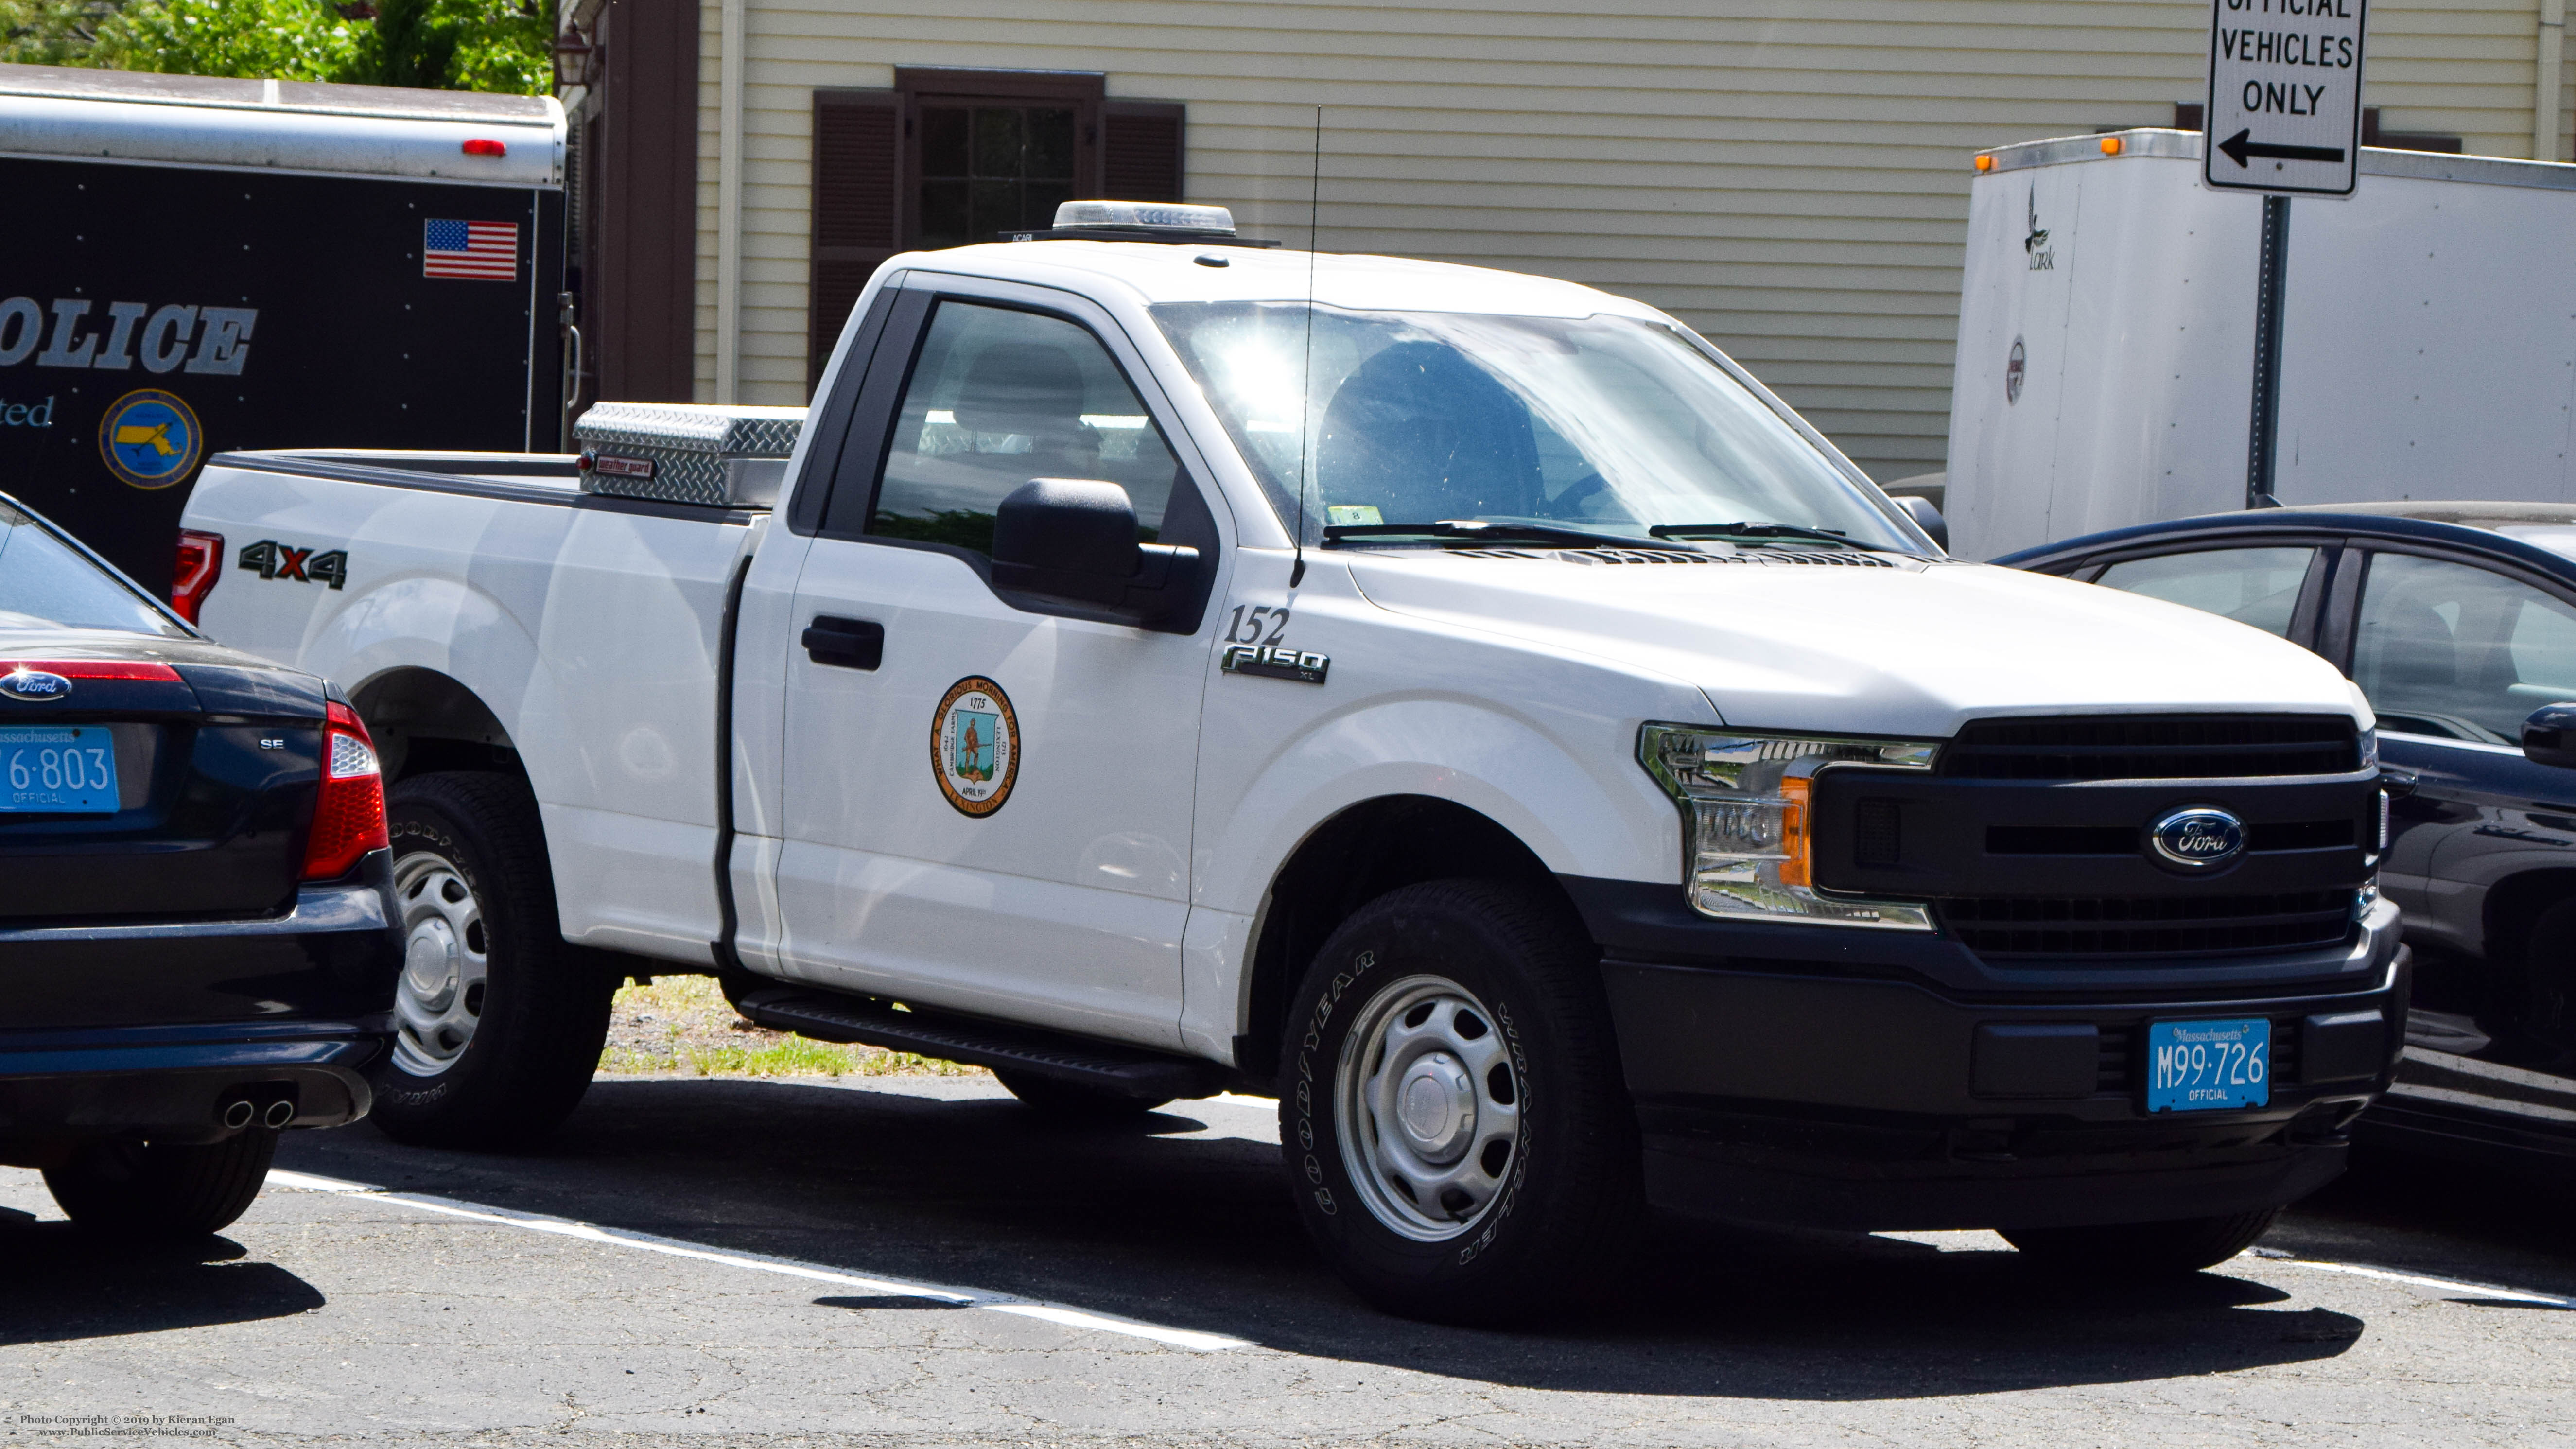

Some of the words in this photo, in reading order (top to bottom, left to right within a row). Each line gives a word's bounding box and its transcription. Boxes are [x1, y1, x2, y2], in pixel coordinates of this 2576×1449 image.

[2222, 28, 2353, 68] VEHICLES
[2244, 80, 2326, 115] ONLY
[0, 296, 259, 375] OLICE
[0, 395, 54, 428] ted
[599, 458, 627, 471] weather
[1224, 604, 1290, 646] 152
[17, 676, 56, 693] Ford
[1300, 671, 1314, 680] XL
[938, 681, 972, 720] GLORIOUS
[976, 681, 1008, 713] MORNING
[1007, 716, 1016, 738] FOR
[970, 697, 986, 709] 1775
[260, 739, 284, 749] SE
[13, 793, 66, 803] OFFICIAL
[962, 787, 976, 797] APRIL
[2179, 821, 2228, 851] Ford
[2176, 1028, 2242, 1043] Massachusetts
[1297, 950, 1375, 1215] GOODYEAR
[2189, 1089, 2228, 1101] OFFICIAL
[1459, 1002, 1532, 1265] WRANGLER
